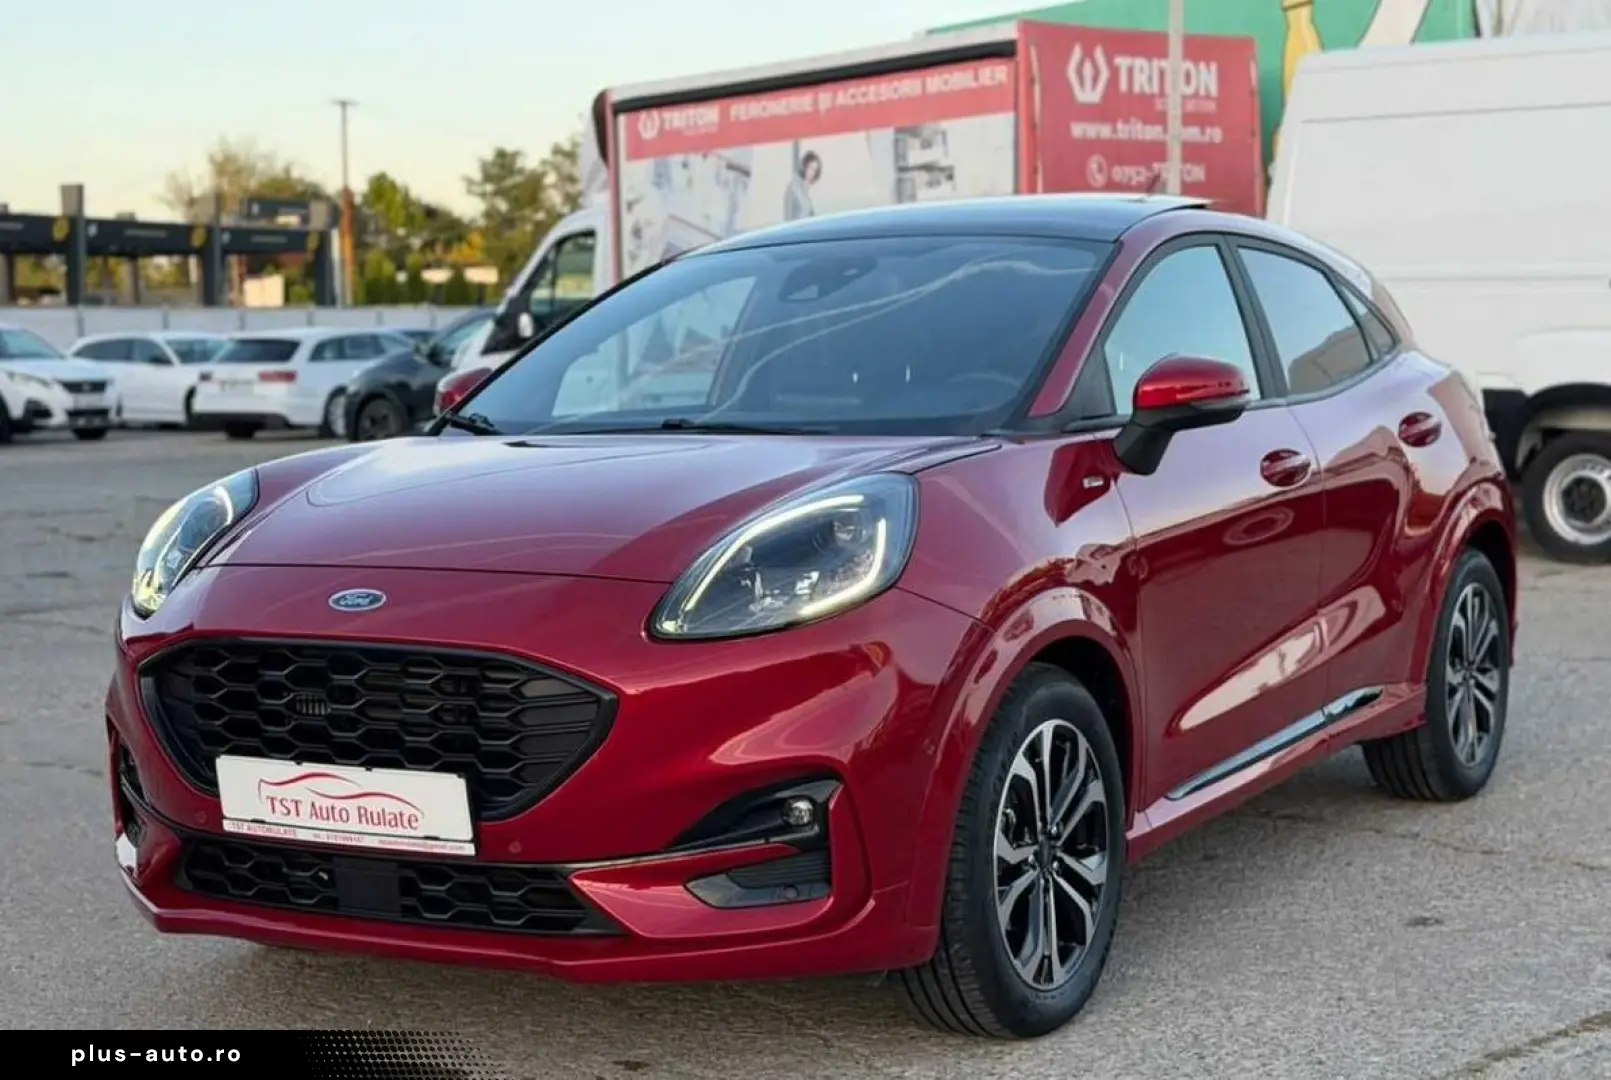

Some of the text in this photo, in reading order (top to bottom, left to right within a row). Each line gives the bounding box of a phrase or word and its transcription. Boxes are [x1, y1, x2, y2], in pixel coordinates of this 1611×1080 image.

[1114, 56, 1218, 97] TRITON
[662, 103, 720, 131] TRITON
[836, 79, 923, 107] ACCESORII
[925, 65, 1009, 94] MOBILIER
[265, 795, 420, 831] TST Auto Rulate
